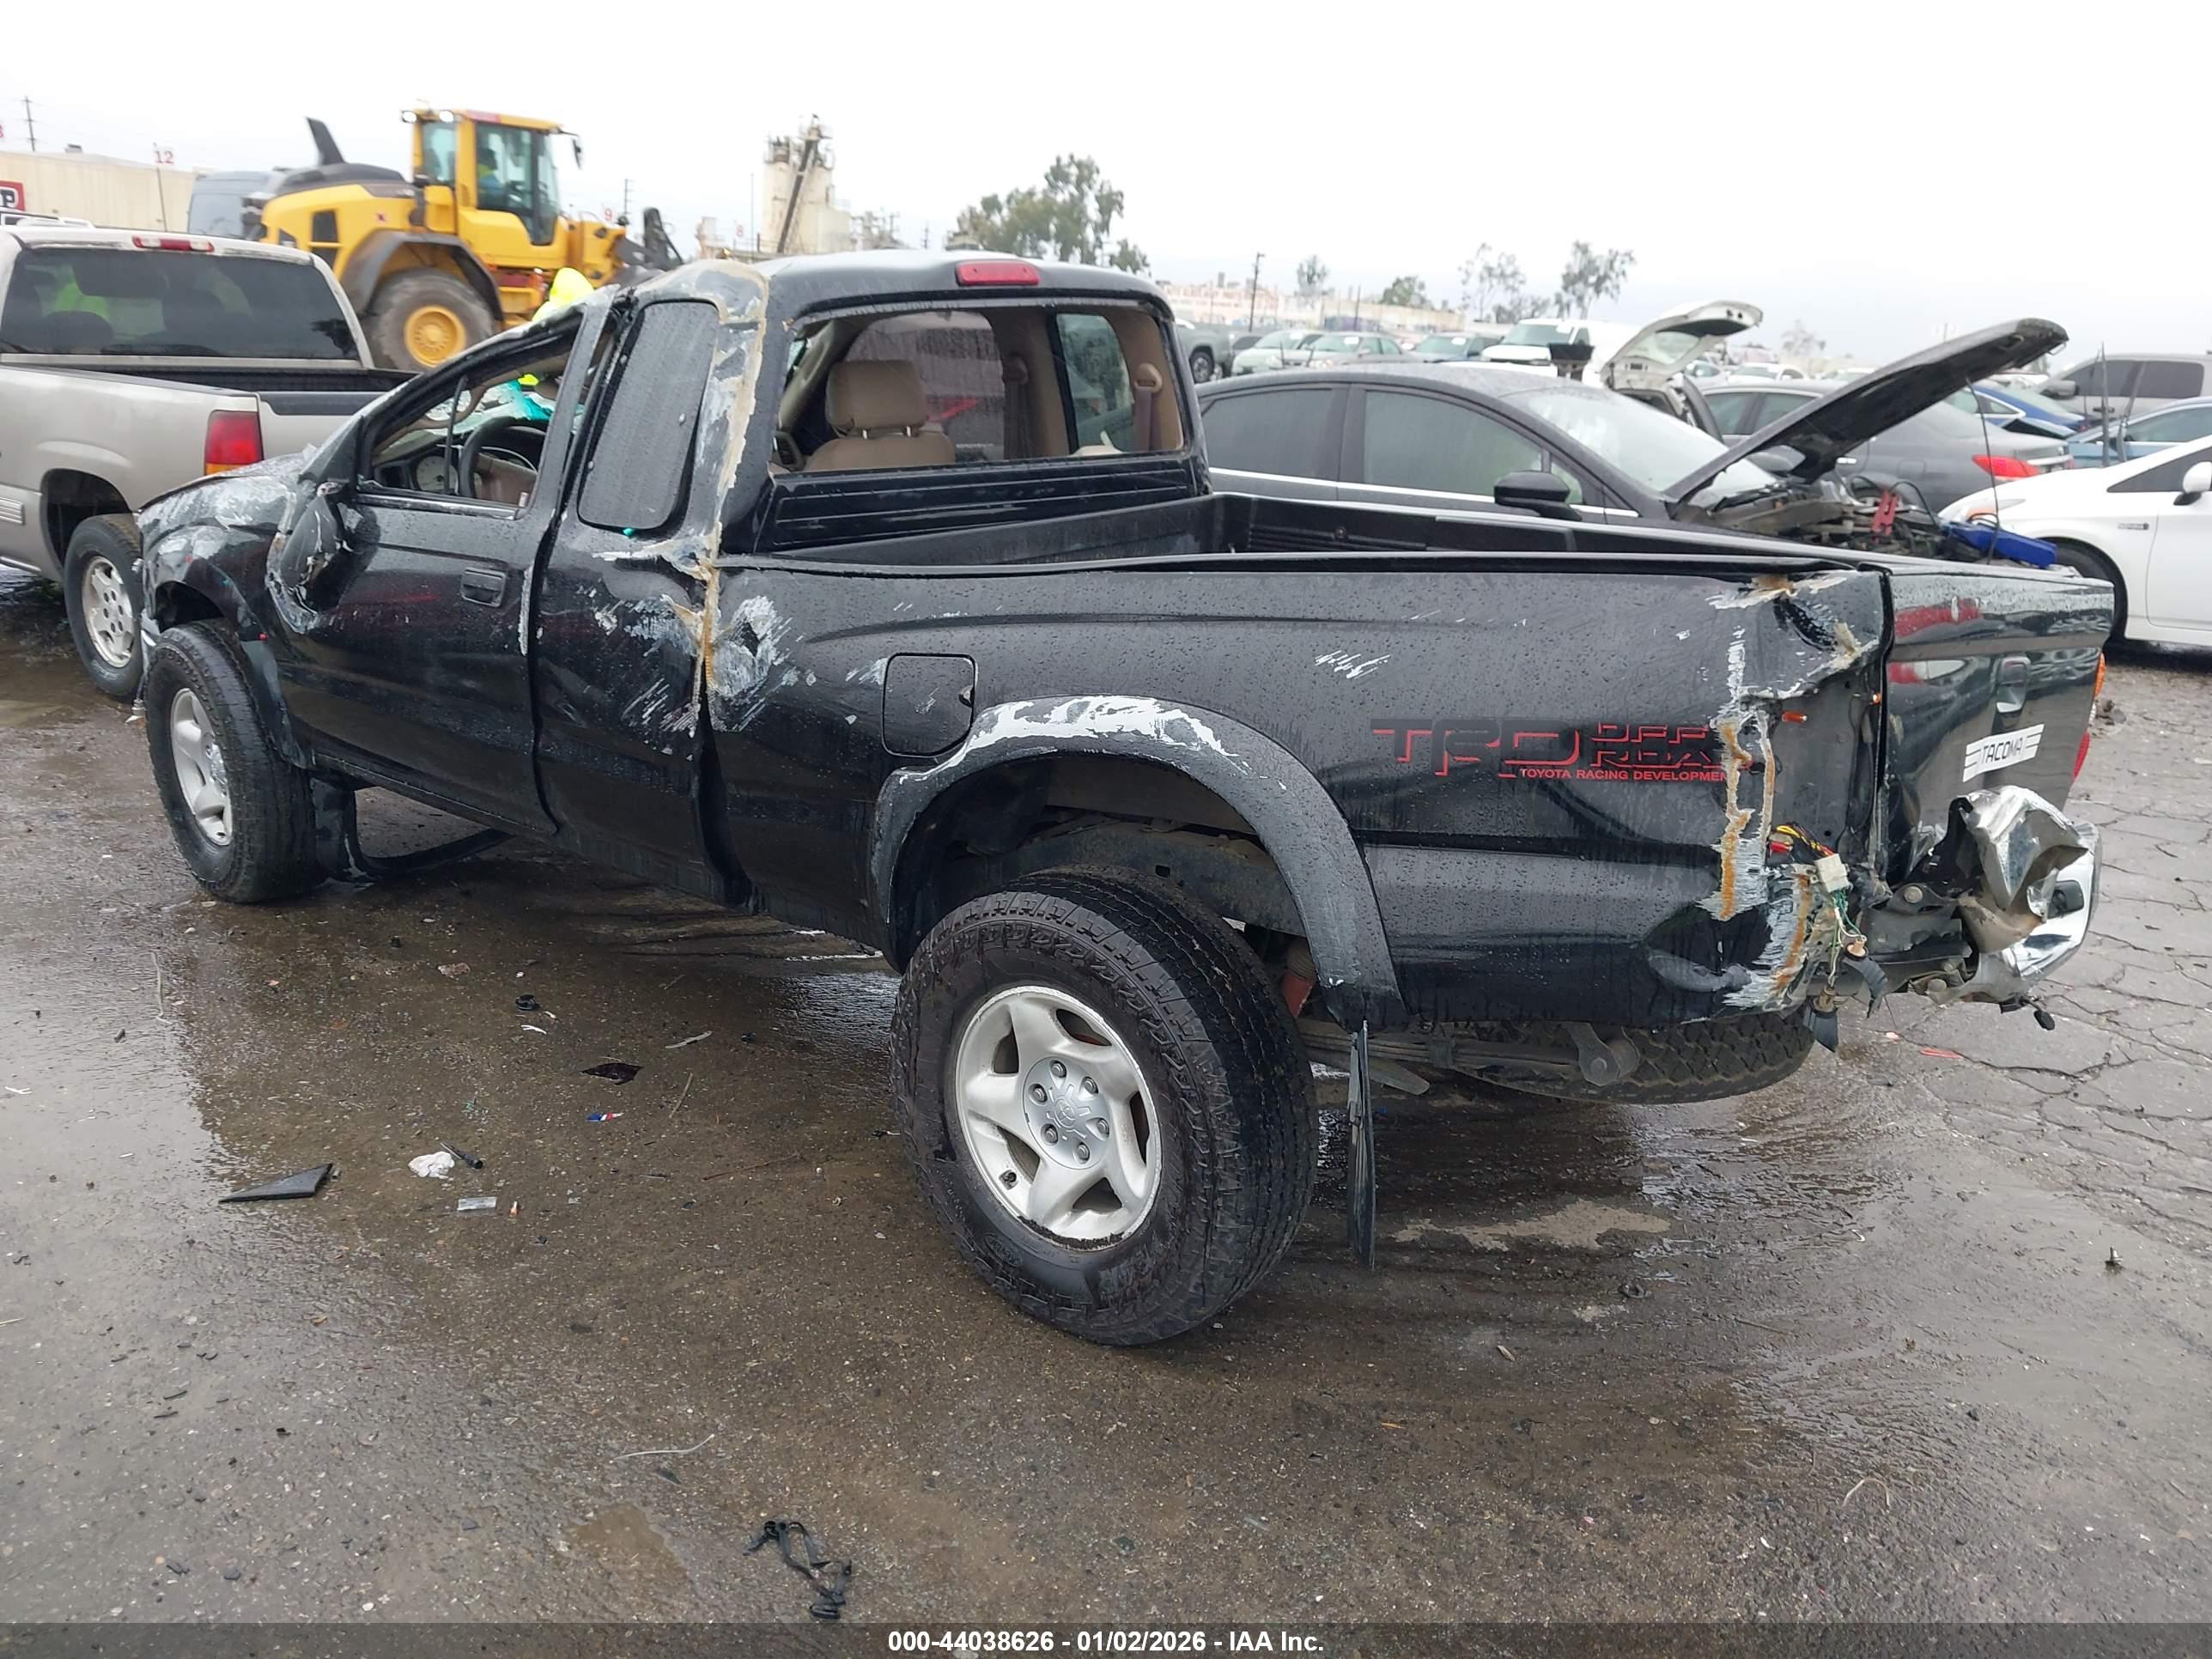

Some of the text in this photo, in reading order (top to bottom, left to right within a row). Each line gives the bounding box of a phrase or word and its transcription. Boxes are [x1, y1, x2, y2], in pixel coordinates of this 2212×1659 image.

[155, 150, 173, 164] 12
[1980, 737, 2024, 764] TACOMA
[1519, 769, 1571, 779] TOYOTA
[1576, 769, 1629, 781] RACING
